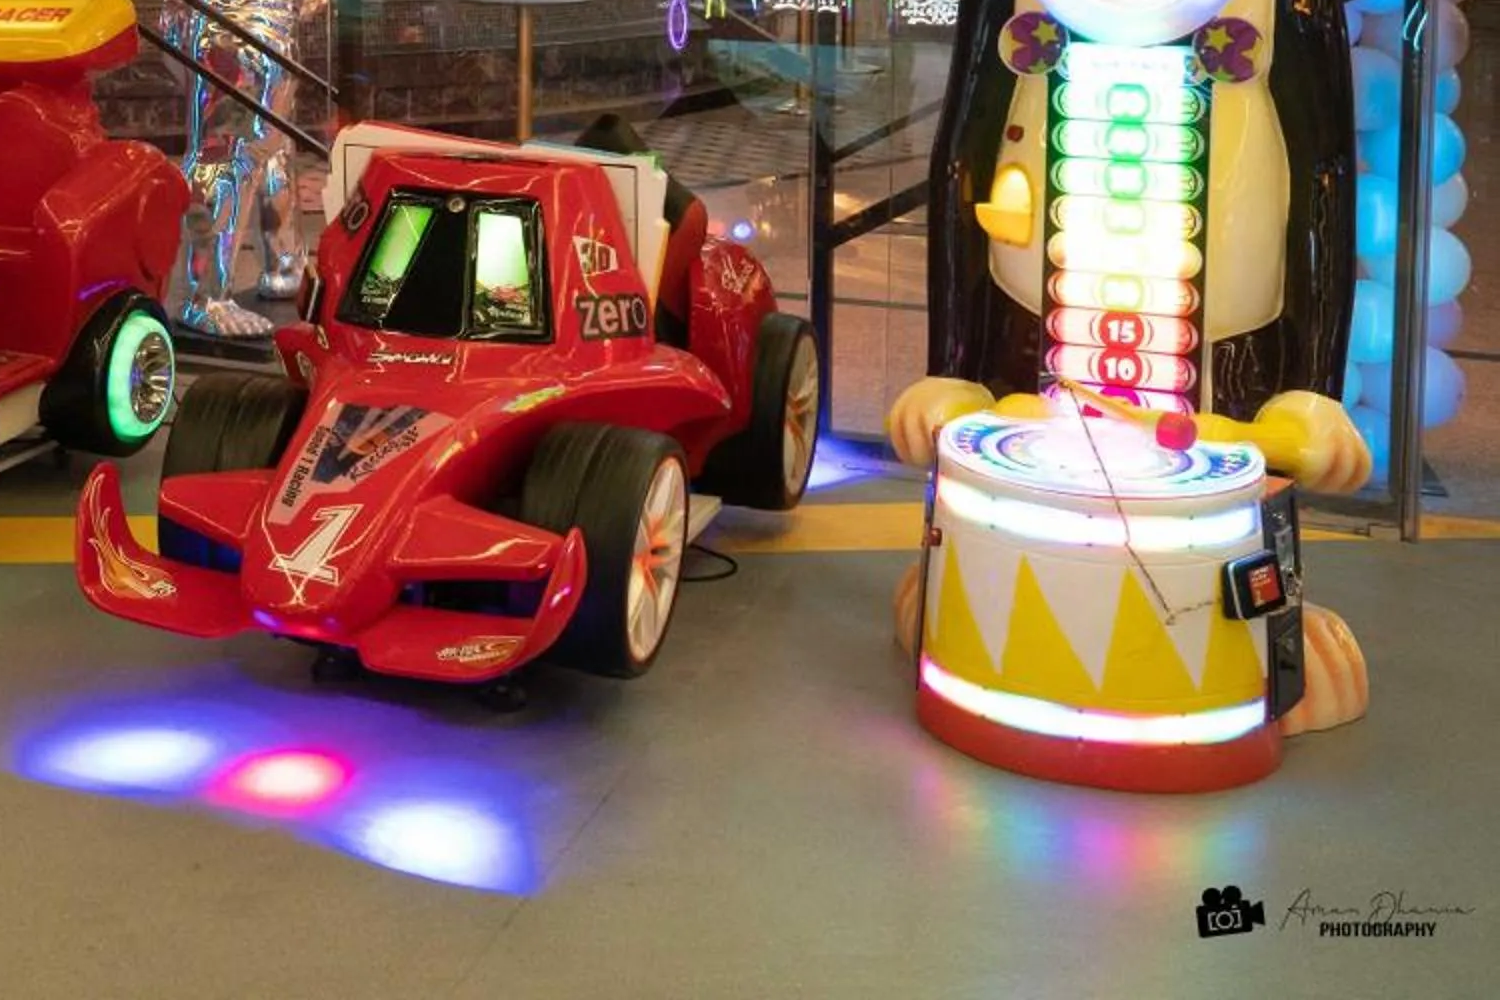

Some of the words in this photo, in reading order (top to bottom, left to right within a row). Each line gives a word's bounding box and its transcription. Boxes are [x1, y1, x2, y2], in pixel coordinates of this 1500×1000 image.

[579, 296, 647, 337] zero
[1107, 319, 1136, 344] 15
[1104, 357, 1137, 381] 10
[267, 503, 364, 587] 1
